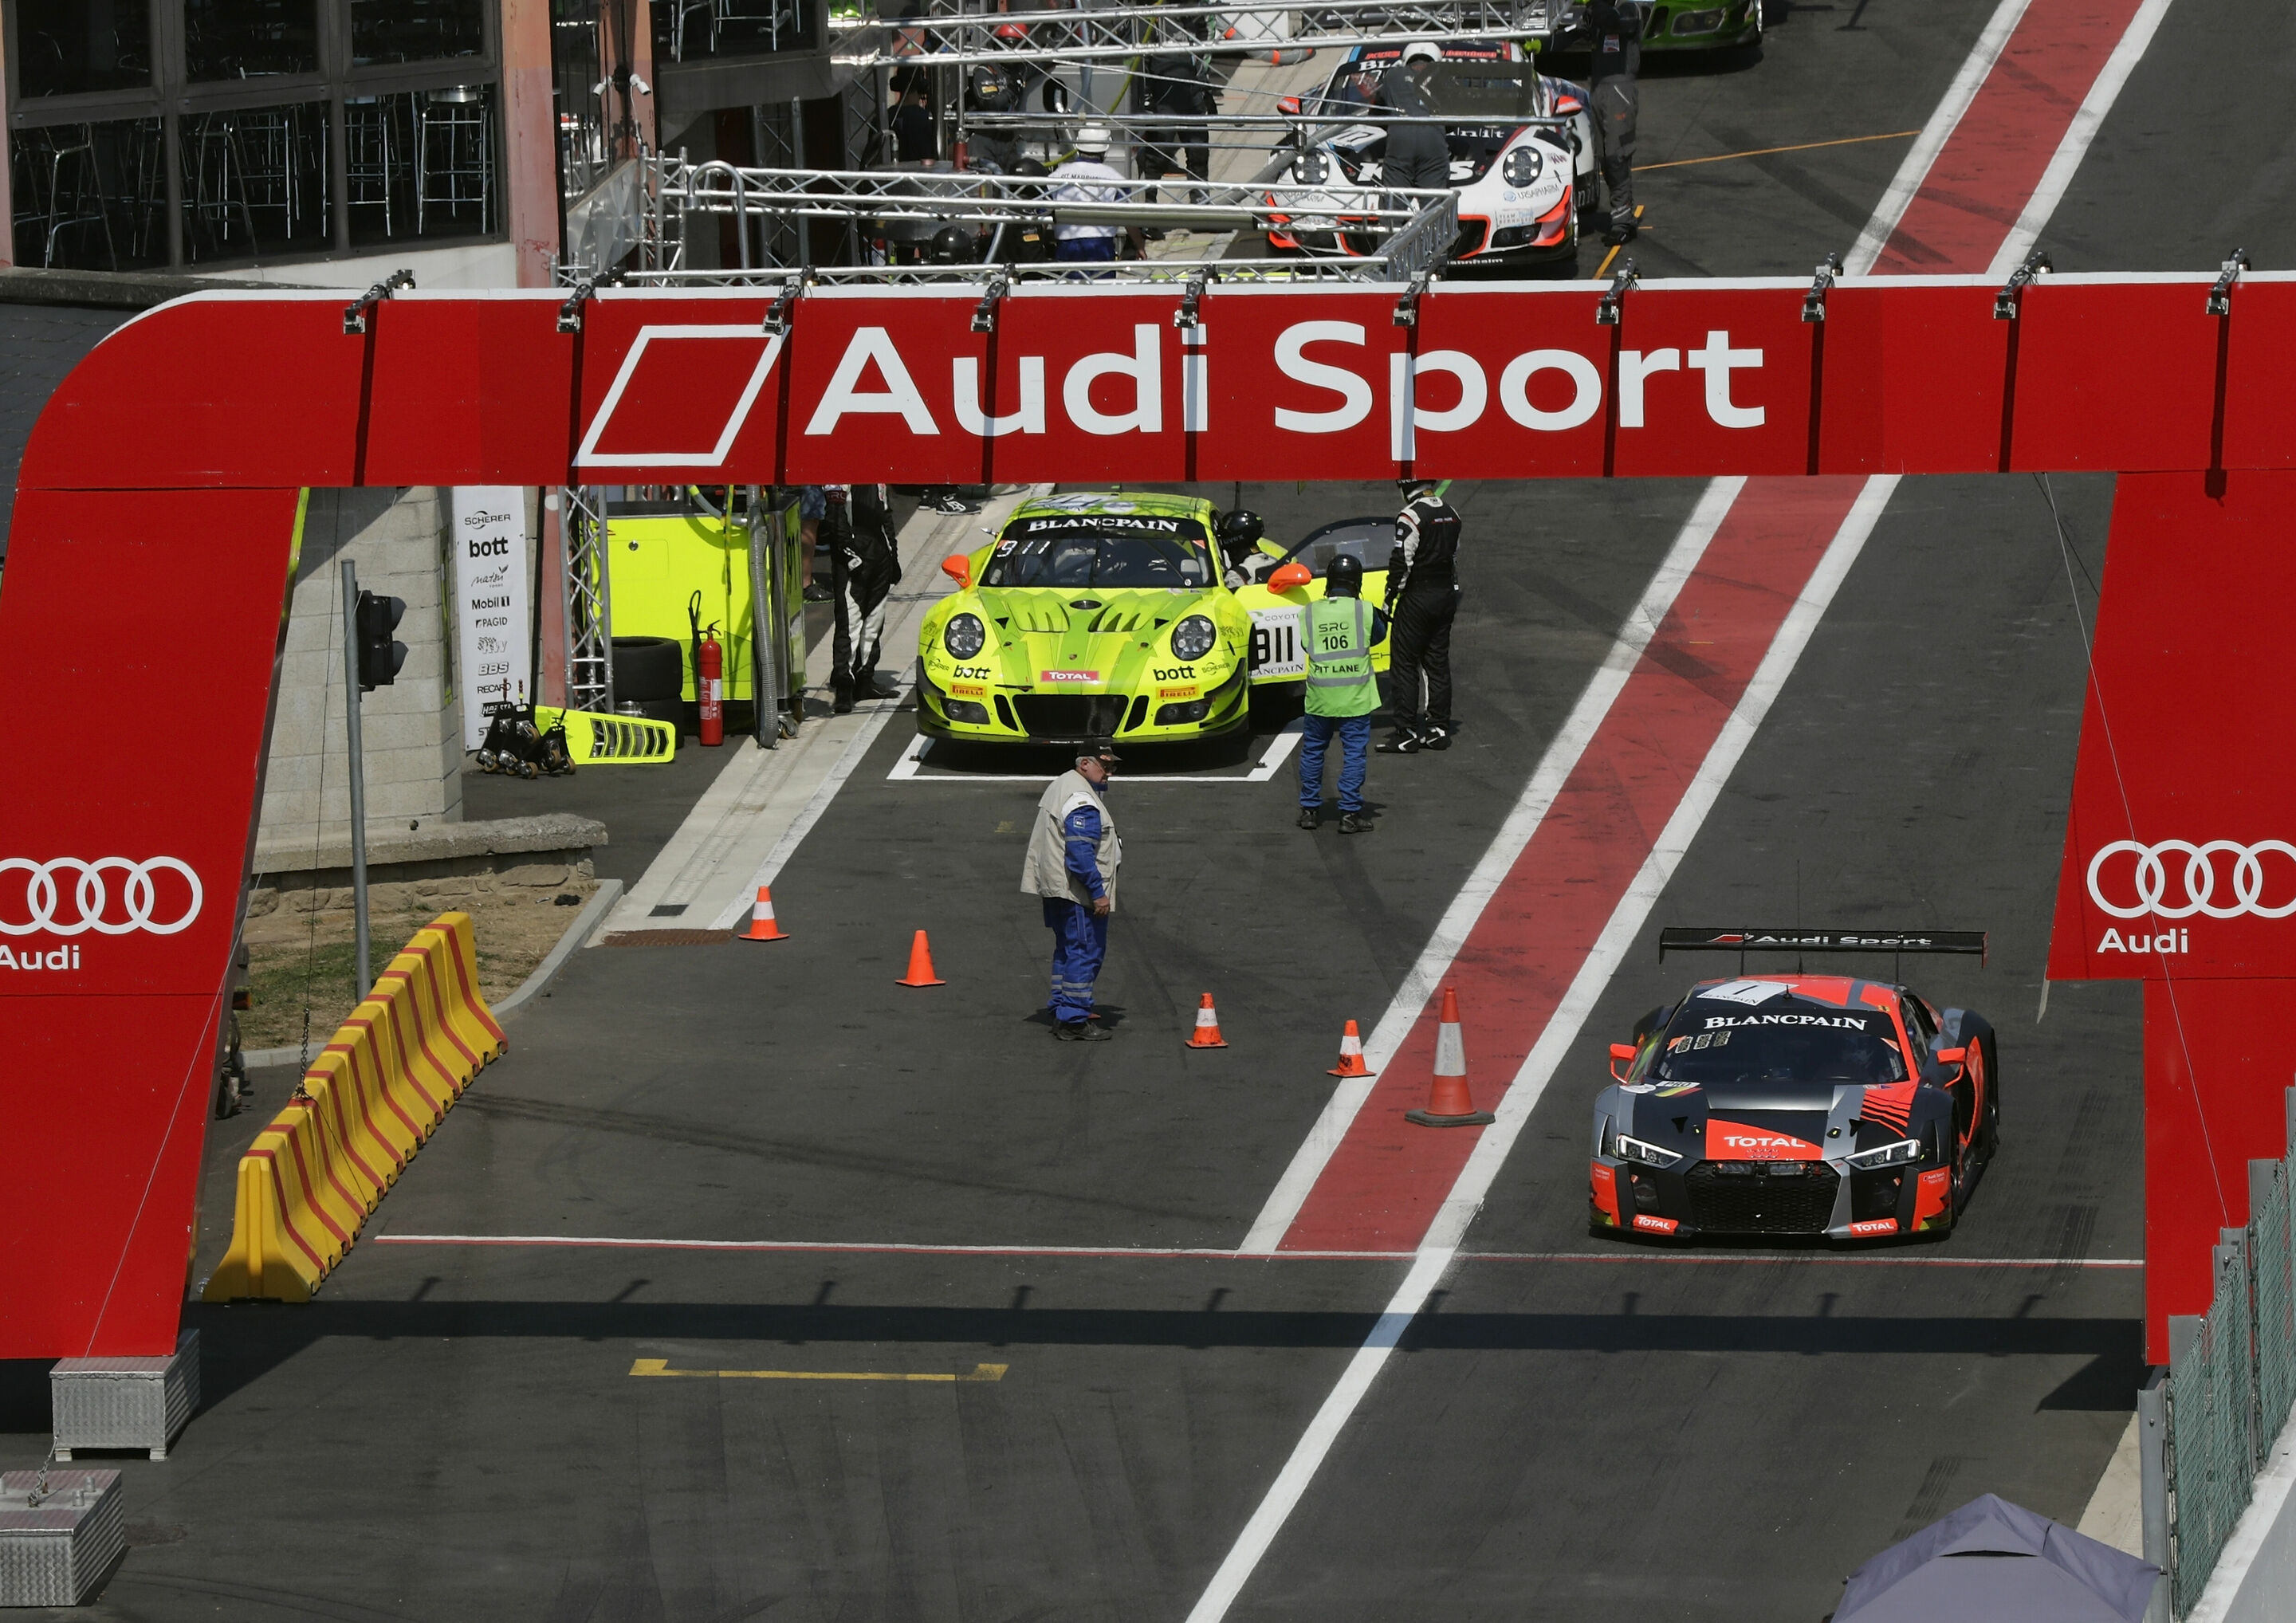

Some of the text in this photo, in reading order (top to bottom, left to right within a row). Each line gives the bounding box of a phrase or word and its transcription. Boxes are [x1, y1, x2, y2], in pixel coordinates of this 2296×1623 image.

[1357, 160, 1476, 181] KS
[804, 320, 1767, 462] Audi Sport
[465, 514, 511, 526] SCHERER
[1027, 517, 1180, 532] BLANCPAIN
[469, 536, 509, 559] bott
[997, 540, 1052, 558] 911
[472, 596, 499, 610] Mobil
[482, 616, 508, 628] PAGID
[1319, 622, 1349, 633] SRC
[1322, 635, 1349, 650] 106
[478, 661, 509, 676] BBS
[953, 664, 992, 680] bott
[1153, 665, 1197, 682] bott
[1201, 662, 1232, 674] SCHERER
[1248, 663, 1304, 678] LANCPAIN
[1314, 663, 1360, 673] PIT LANE
[1049, 671, 1091, 680] TOTAL
[952, 685, 984, 696] PIRELLI
[1160, 686, 1196, 698] PIRELLI
[1839, 936, 1932, 945] Sport
[2096, 927, 2189, 954] Audi
[0, 945, 81, 970] Audi
[1732, 984, 1759, 996] 1
[1702, 993, 1759, 1004] BLANCPAIN
[1703, 1014, 1868, 1032] BLANCPAIN
[1723, 1135, 1807, 1149] TOTAL
[1638, 1216, 1670, 1230] TOTAL
[1852, 1221, 1895, 1232] TOTAL
